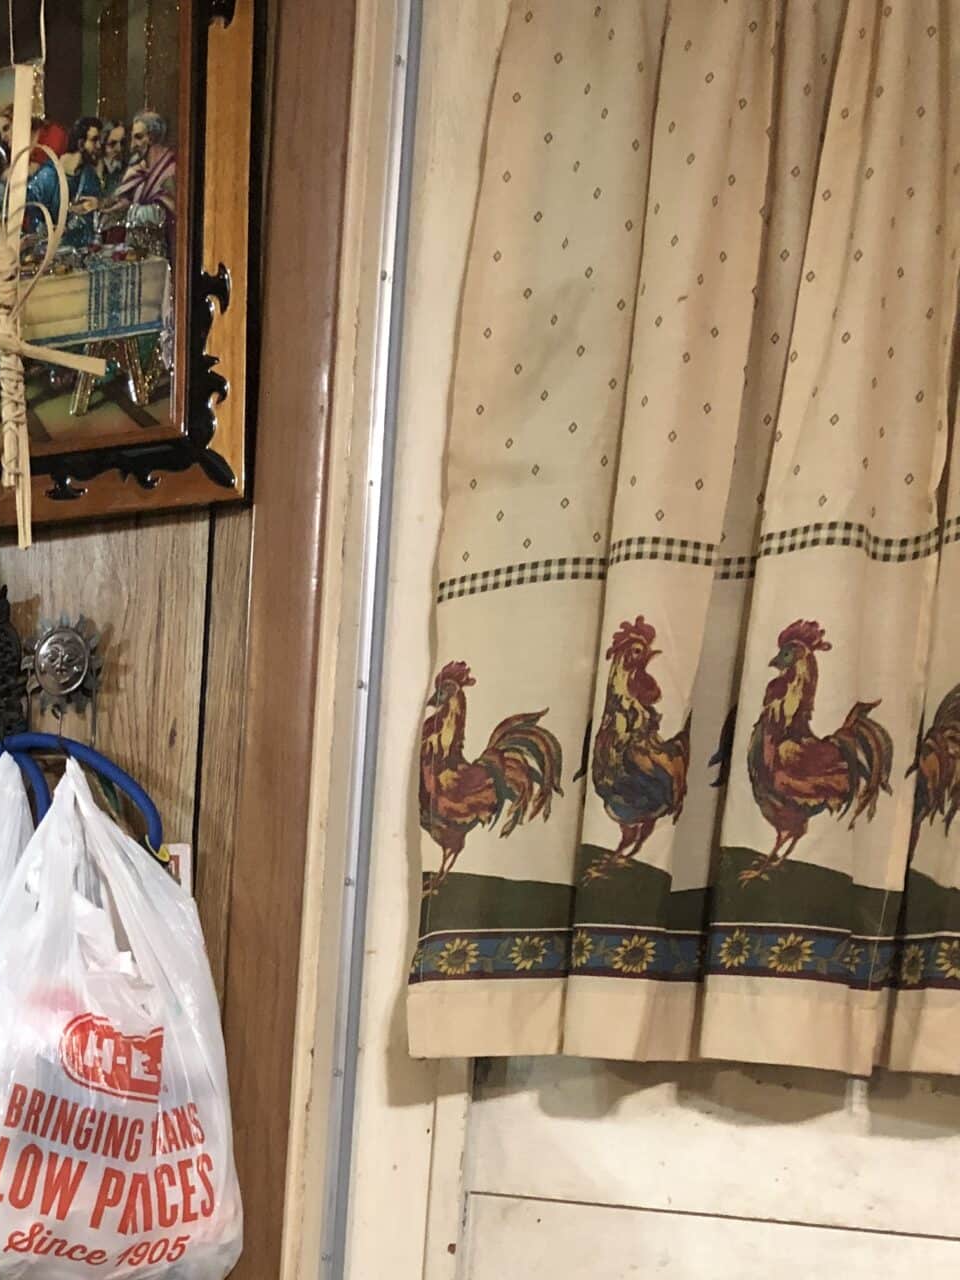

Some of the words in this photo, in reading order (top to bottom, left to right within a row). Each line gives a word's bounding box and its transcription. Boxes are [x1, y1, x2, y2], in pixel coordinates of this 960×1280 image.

[4, 1083, 144, 1162] BRINGING
[3, 1222, 108, 1267] Since
[115, 1235, 191, 1267] 1905
